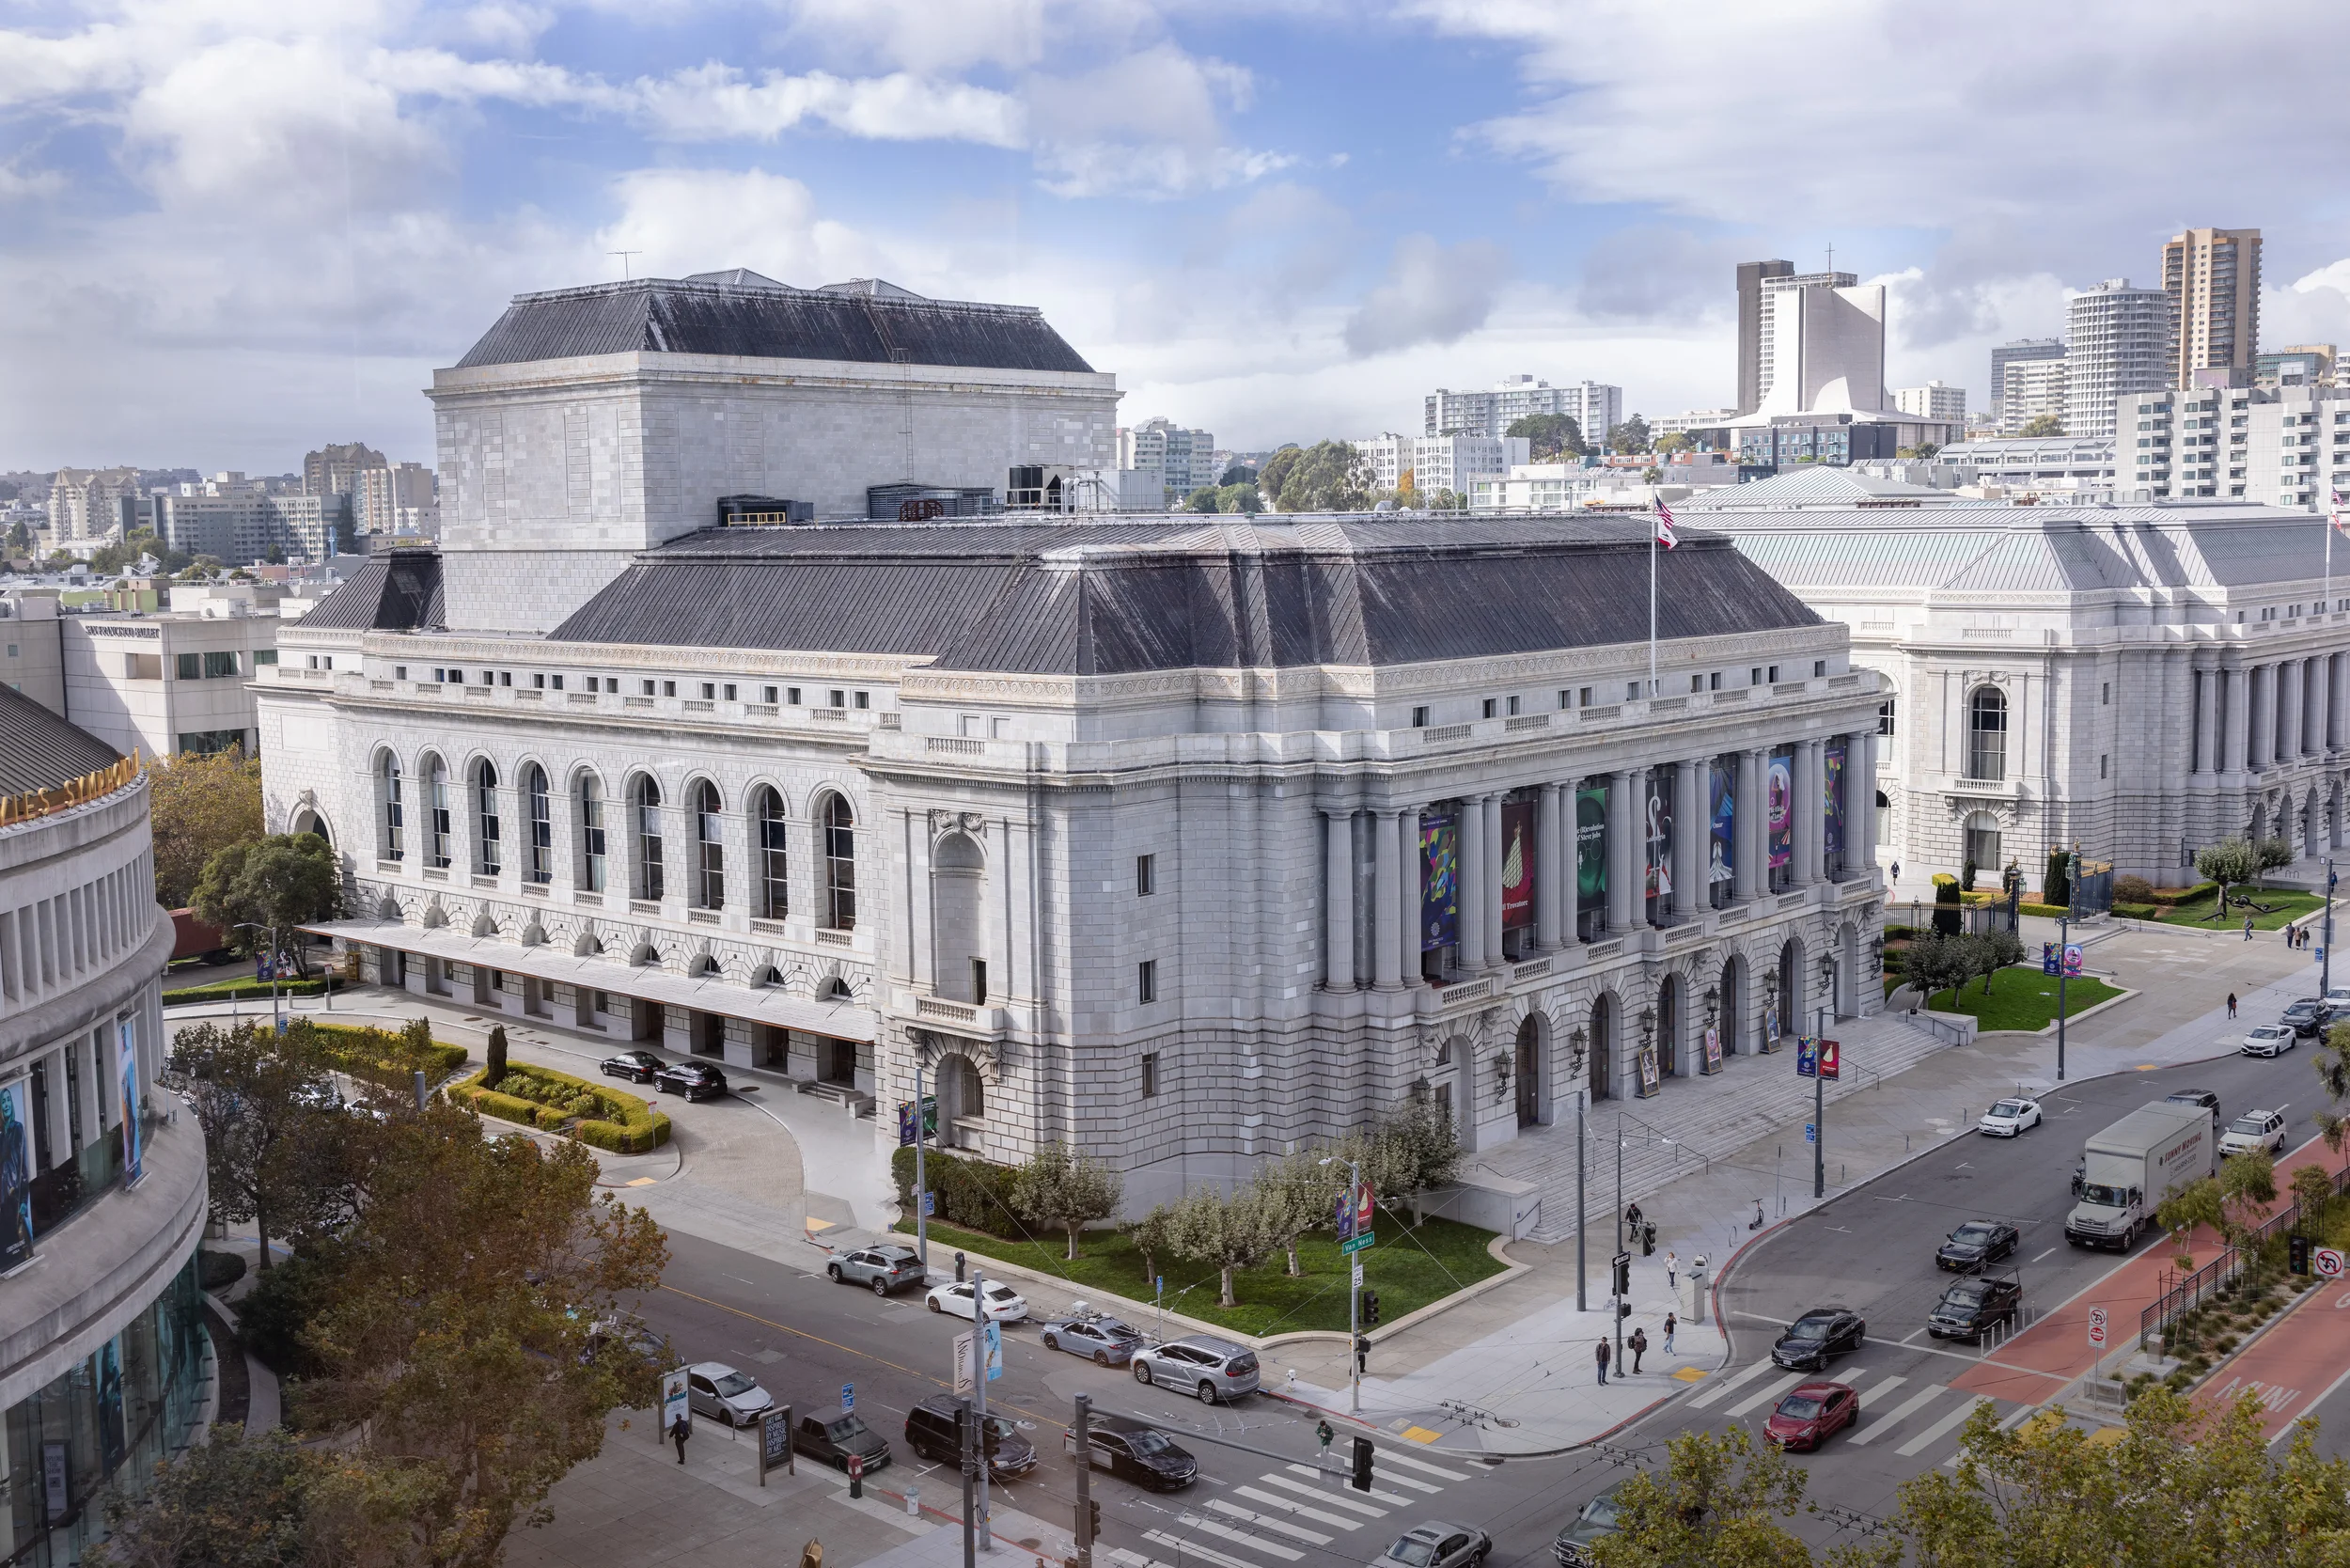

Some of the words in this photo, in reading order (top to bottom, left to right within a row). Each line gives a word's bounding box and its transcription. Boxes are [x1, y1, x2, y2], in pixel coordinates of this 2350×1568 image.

[85, 625, 98, 635] SAN
[99, 626, 134, 637] FRANCISCO
[134, 627, 160, 638] BALLET
[1507, 901, 1528, 909] Trovatore
[2165, 1144, 2181, 1163] SUNNY
[2182, 1132, 2201, 1152] MOVING
[1344, 1243, 1355, 1252] Van
[1357, 1236, 1372, 1247] Ness
[1354, 1278, 1362, 1287] 25
[2215, 1376, 2301, 1413] MUNI
[765, 1417, 774, 1425] ART
[765, 1420, 786, 1434] INSPIRED
[766, 1432, 772, 1440] BY
[772, 1428, 787, 1438] MUSIC
[766, 1435, 787, 1448] INSPIRED
[767, 1446, 773, 1454] BY
[773, 1444, 782, 1452] ART
